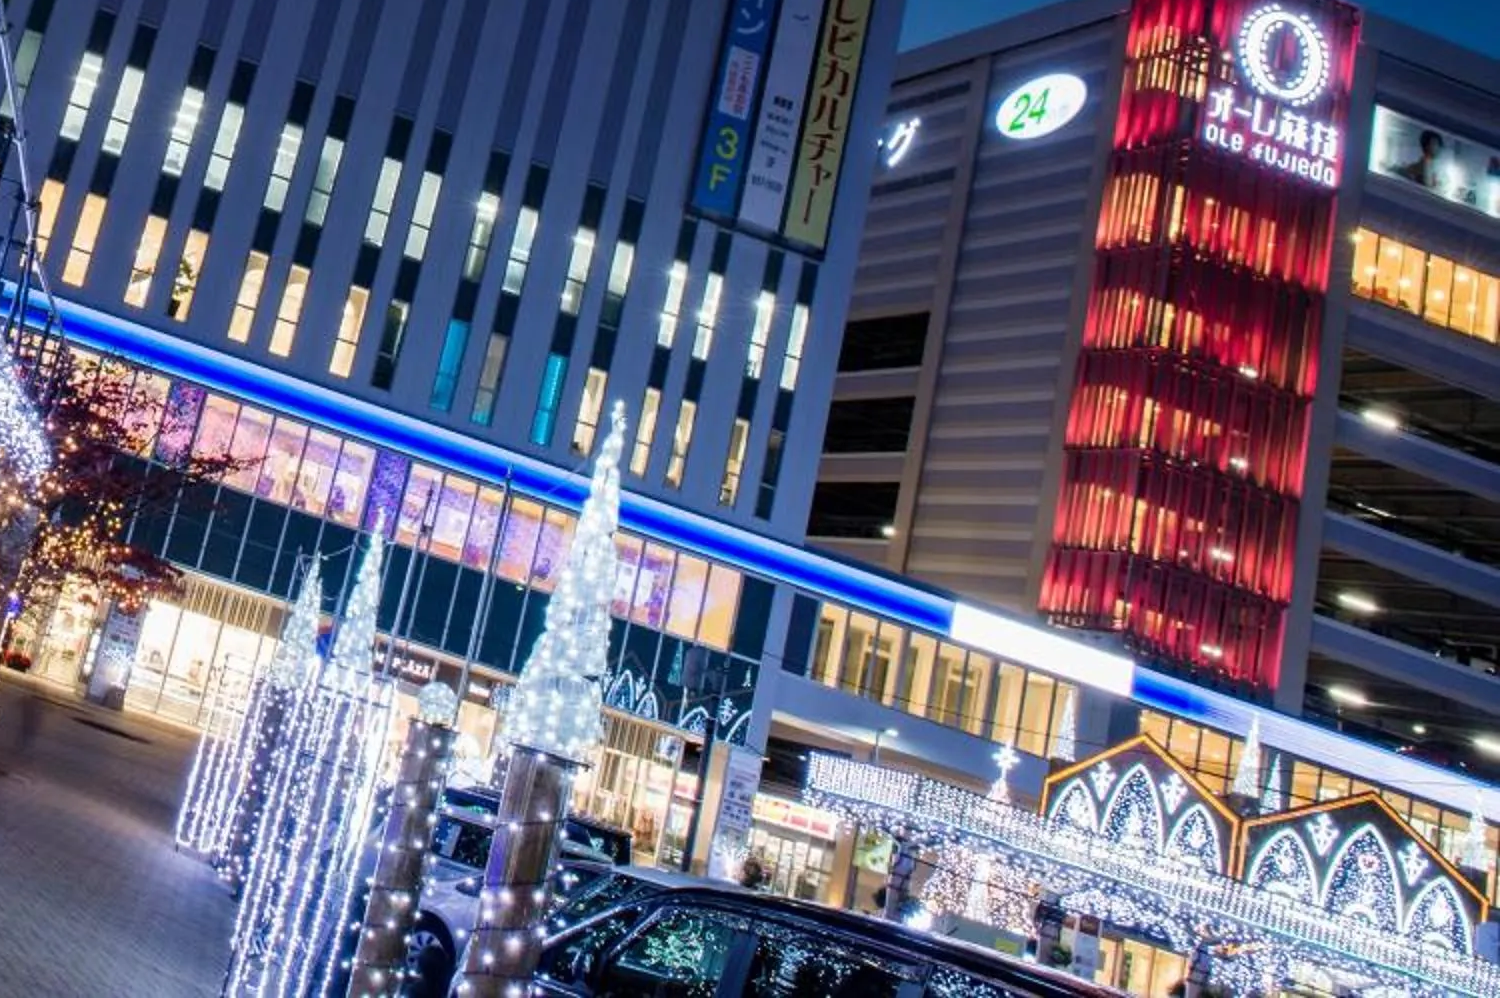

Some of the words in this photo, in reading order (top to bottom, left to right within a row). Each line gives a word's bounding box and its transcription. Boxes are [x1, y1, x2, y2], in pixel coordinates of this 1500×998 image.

[1008, 88, 1050, 132] 24
[708, 127, 740, 191] 3F
[876, 114, 923, 168] グ
